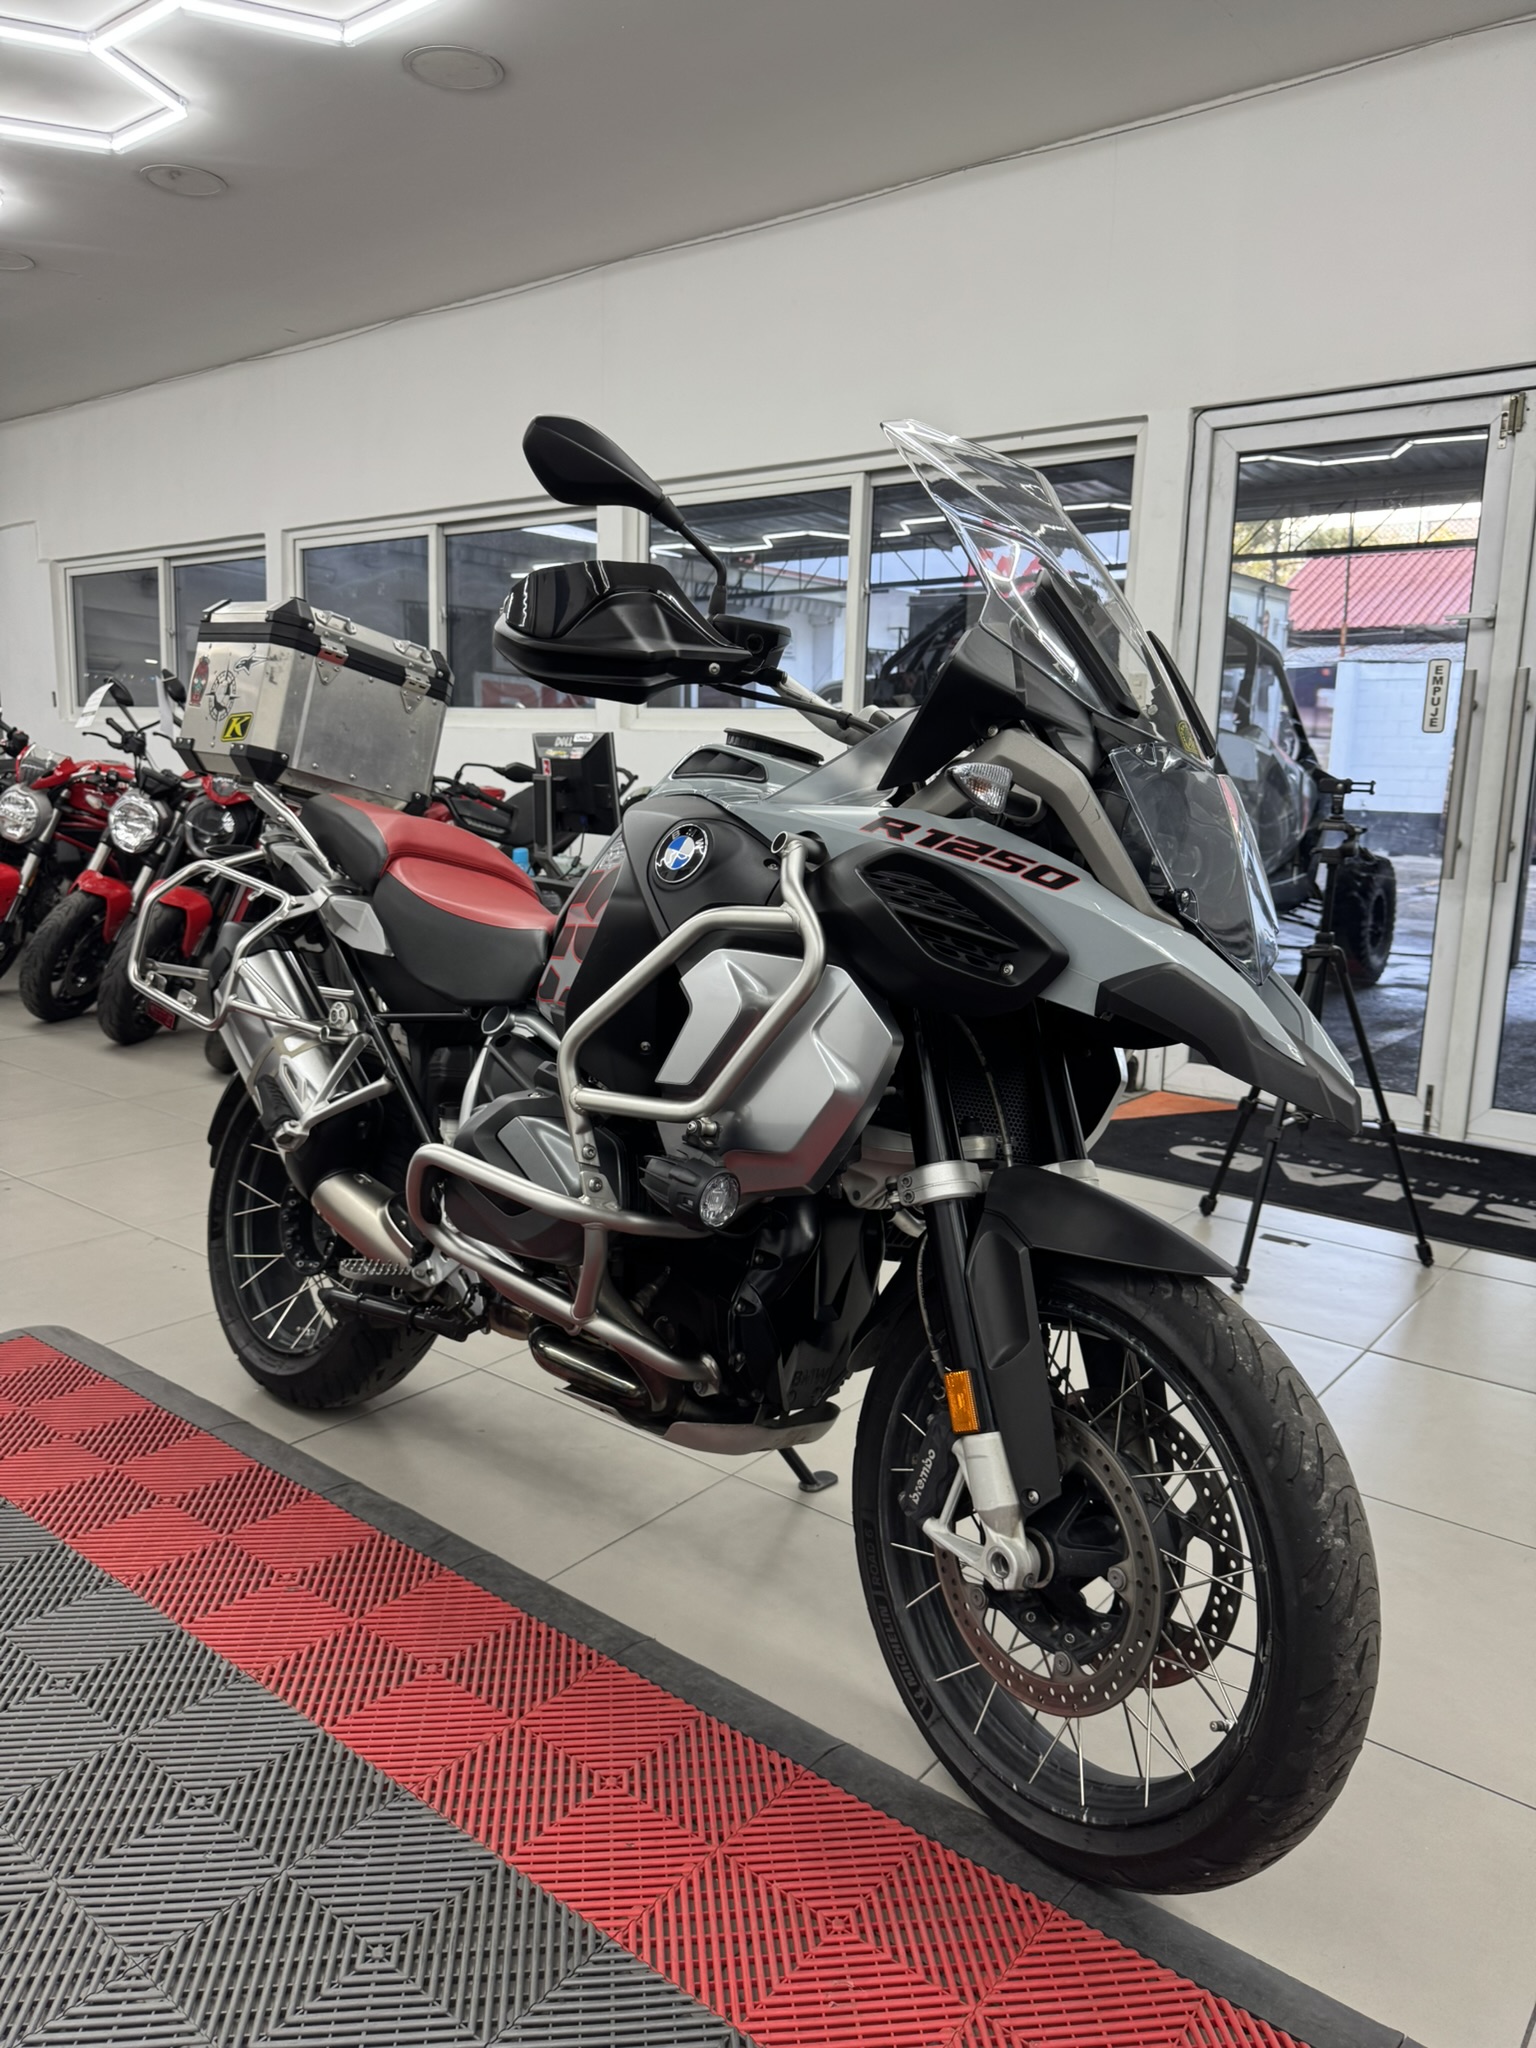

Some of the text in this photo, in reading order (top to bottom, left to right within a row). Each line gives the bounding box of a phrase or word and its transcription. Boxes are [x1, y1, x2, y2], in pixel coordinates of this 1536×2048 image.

[1429, 665, 1444, 727] EMPUJE
[223, 716, 251, 738] K
[859, 815, 1081, 891] R 1250
[1191, 1136, 1291, 1159] RDNG
[908, 1448, 936, 1505] brembo
[864, 1542, 882, 1587] ROAD
[878, 1604, 918, 1687] MICHELIN
